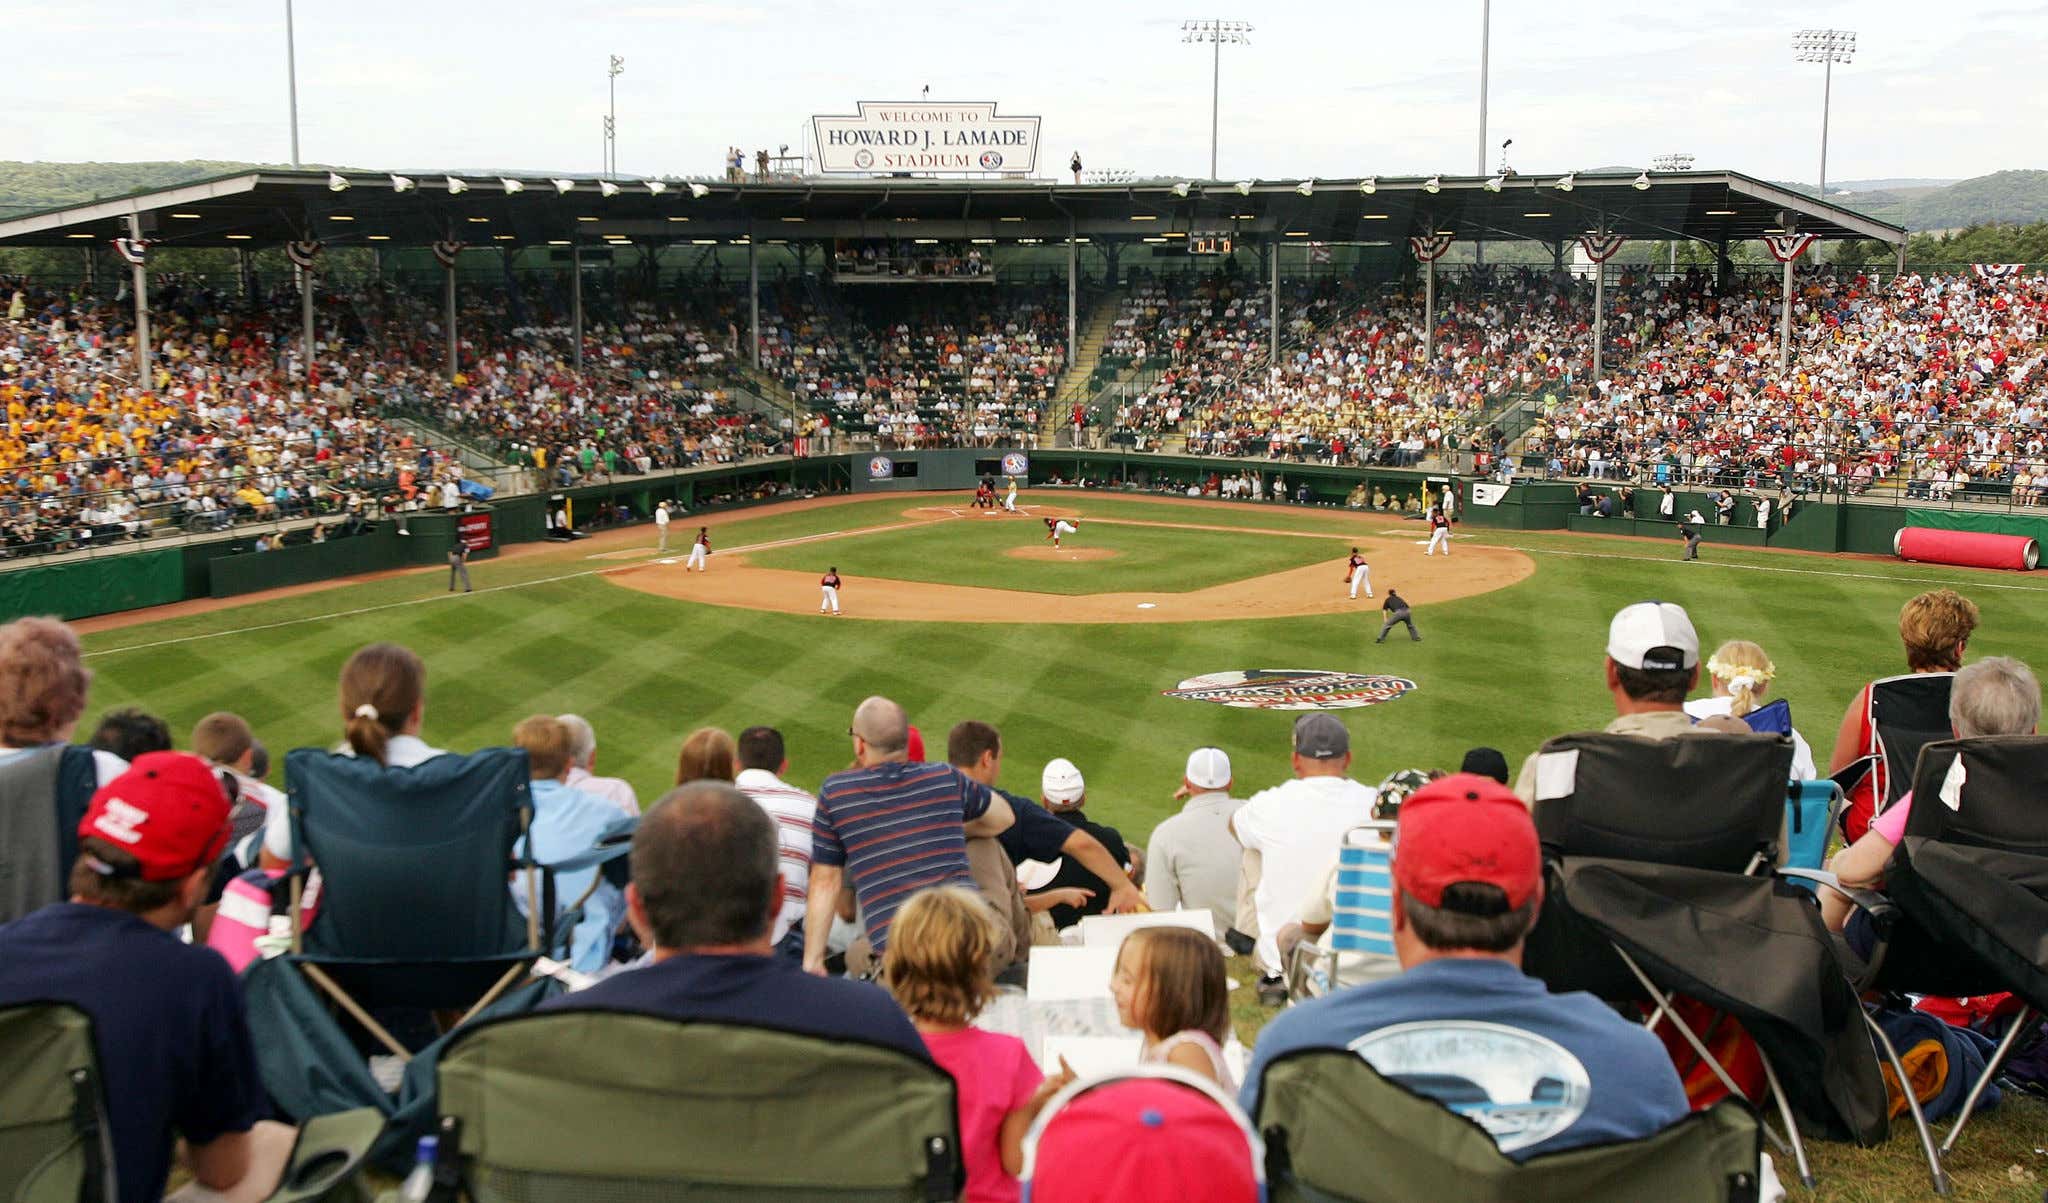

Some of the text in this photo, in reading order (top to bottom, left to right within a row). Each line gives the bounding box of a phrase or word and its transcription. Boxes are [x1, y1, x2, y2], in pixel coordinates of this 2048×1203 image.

[880, 111, 979, 122] WELCOME TO
[829, 129, 1027, 152] HOWARD J. LAMADE
[884, 153, 970, 167] STADIUM
